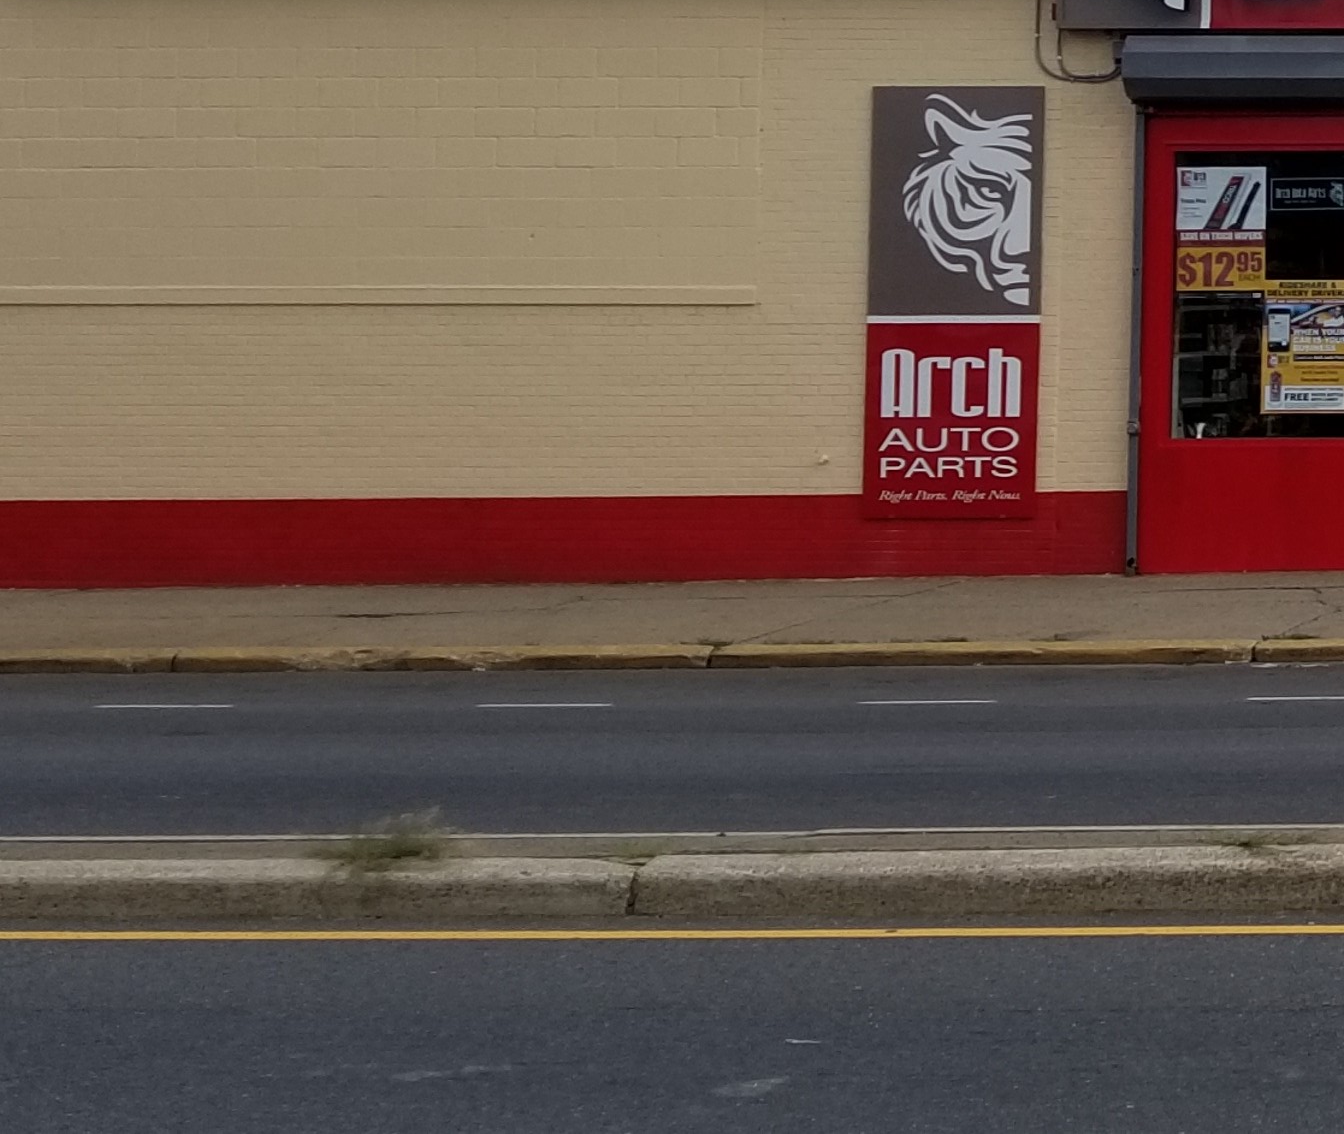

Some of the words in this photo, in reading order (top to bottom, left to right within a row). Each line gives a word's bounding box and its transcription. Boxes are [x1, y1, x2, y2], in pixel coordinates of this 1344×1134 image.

[880, 347, 1022, 418] Arch
[1284, 392, 1310, 402] FREE
[878, 426, 1020, 453] AUTO
[879, 456, 1018, 479] PARTS
[878, 489, 912, 504] Right
[952, 489, 985, 504] Right
